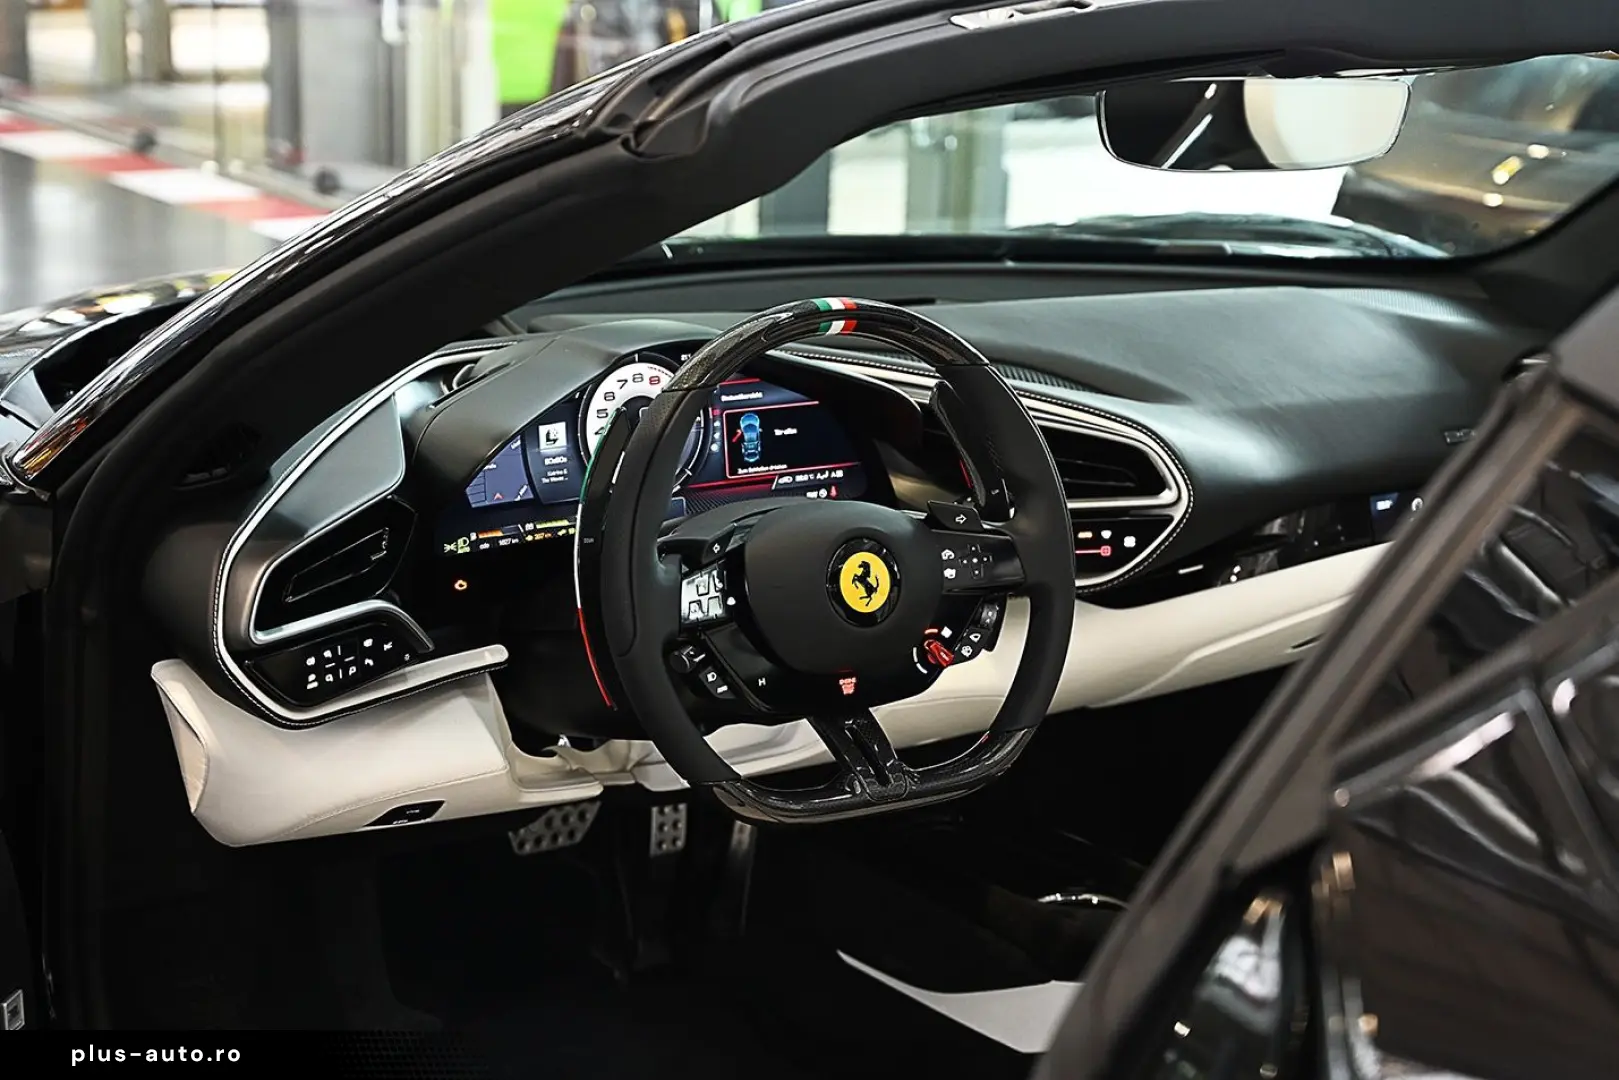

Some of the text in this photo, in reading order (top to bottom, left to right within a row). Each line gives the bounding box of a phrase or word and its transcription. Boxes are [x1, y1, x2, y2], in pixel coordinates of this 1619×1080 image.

[616, 379, 628, 389] 7
[648, 375, 661, 385] 9
[596, 408, 608, 418] 5
[758, 677, 766, 687] H
